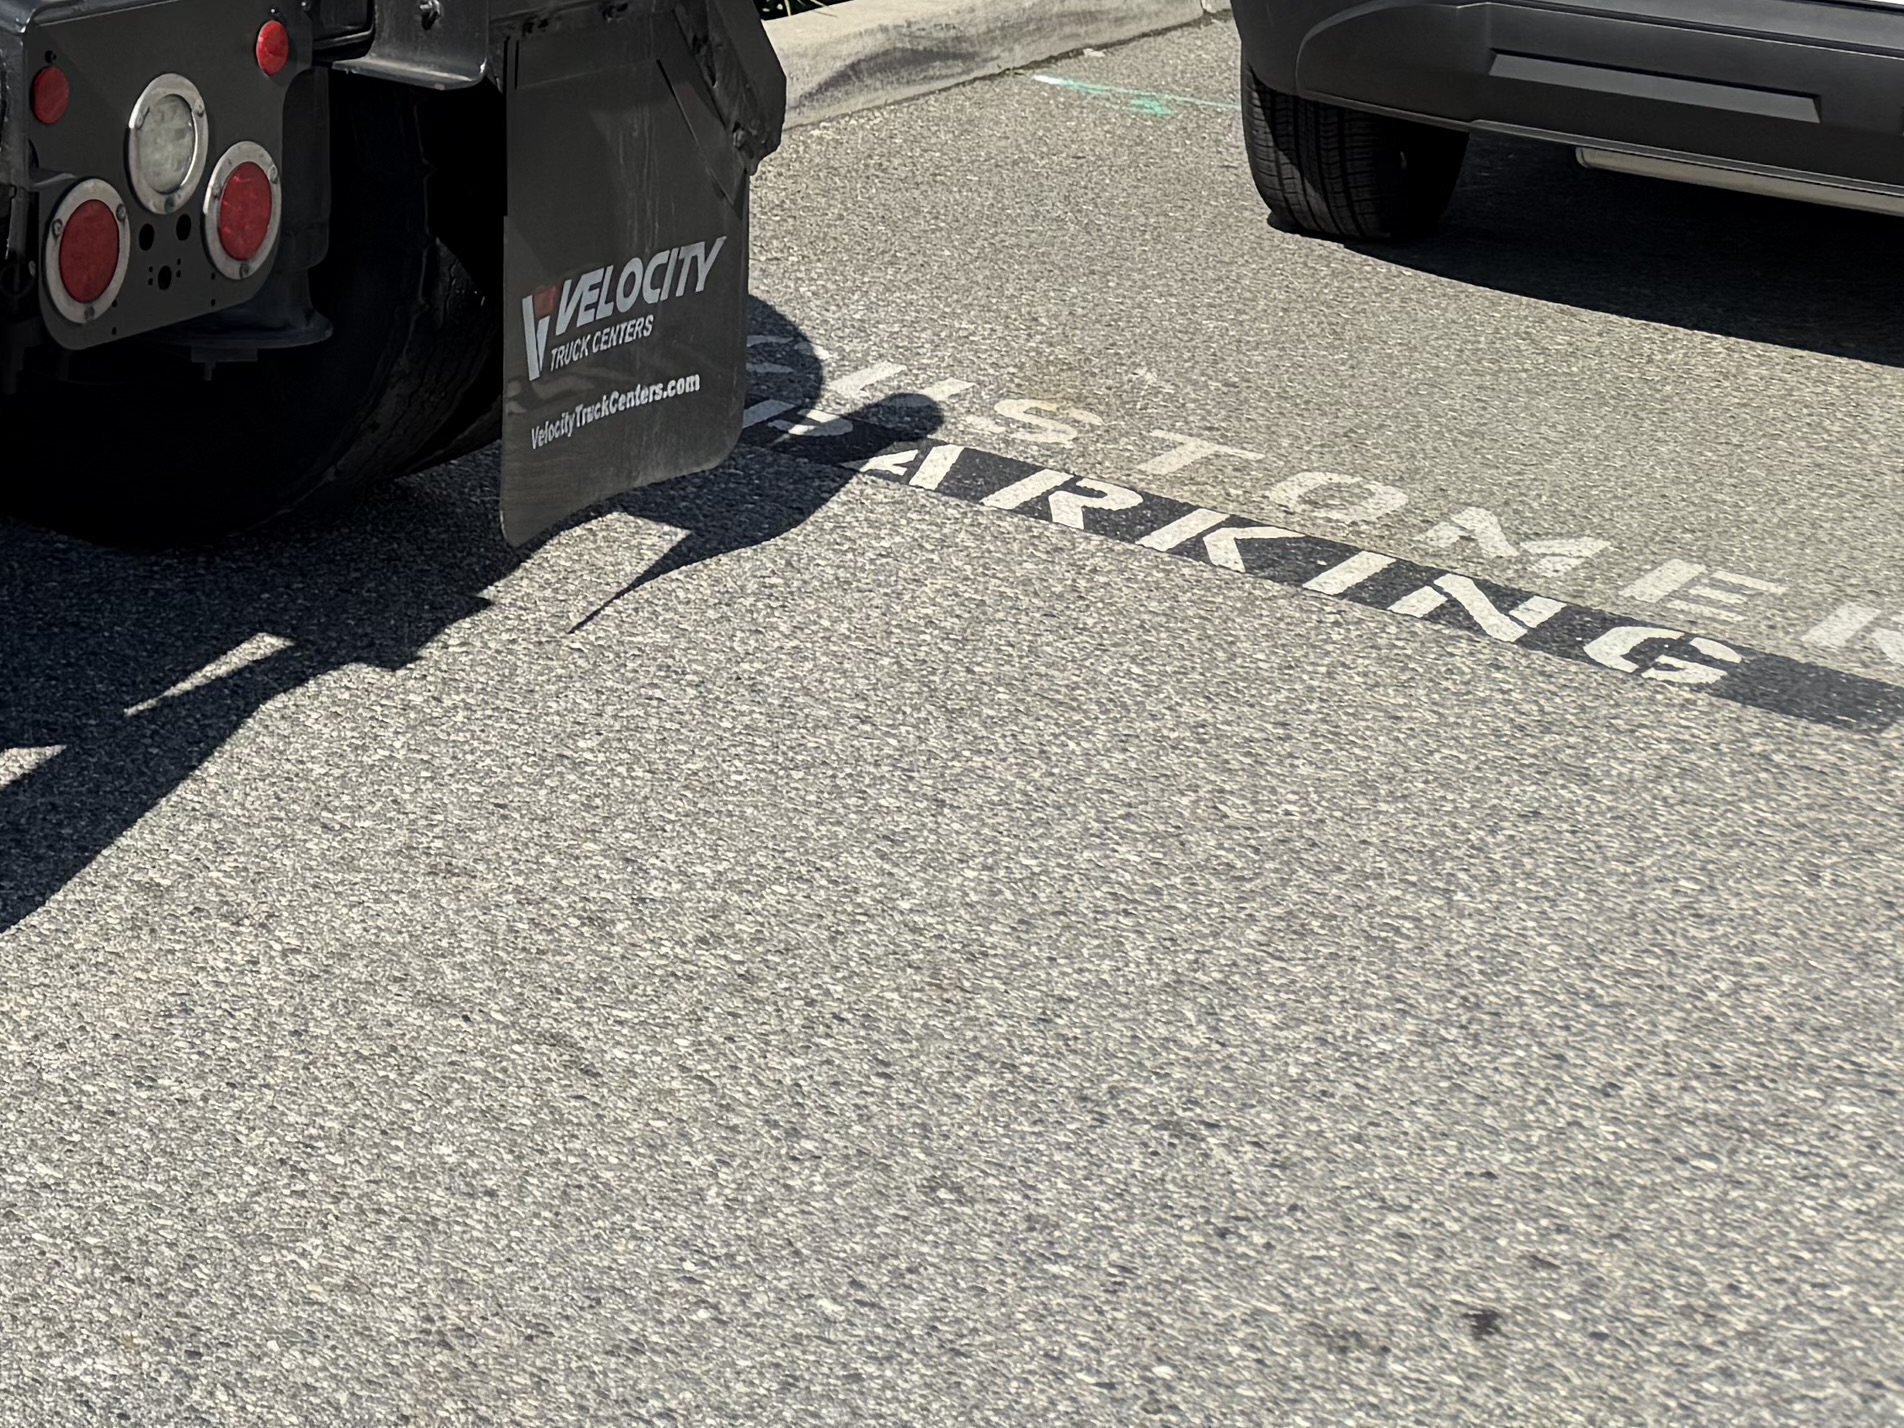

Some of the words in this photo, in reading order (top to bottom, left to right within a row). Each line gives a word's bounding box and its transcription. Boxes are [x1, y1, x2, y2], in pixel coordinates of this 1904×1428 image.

[555, 236, 727, 336] VELOCITY
[550, 334, 591, 372] TRUCK
[592, 314, 654, 354] CENTERS
[531, 373, 700, 450] VelocityTruckCenters.com
